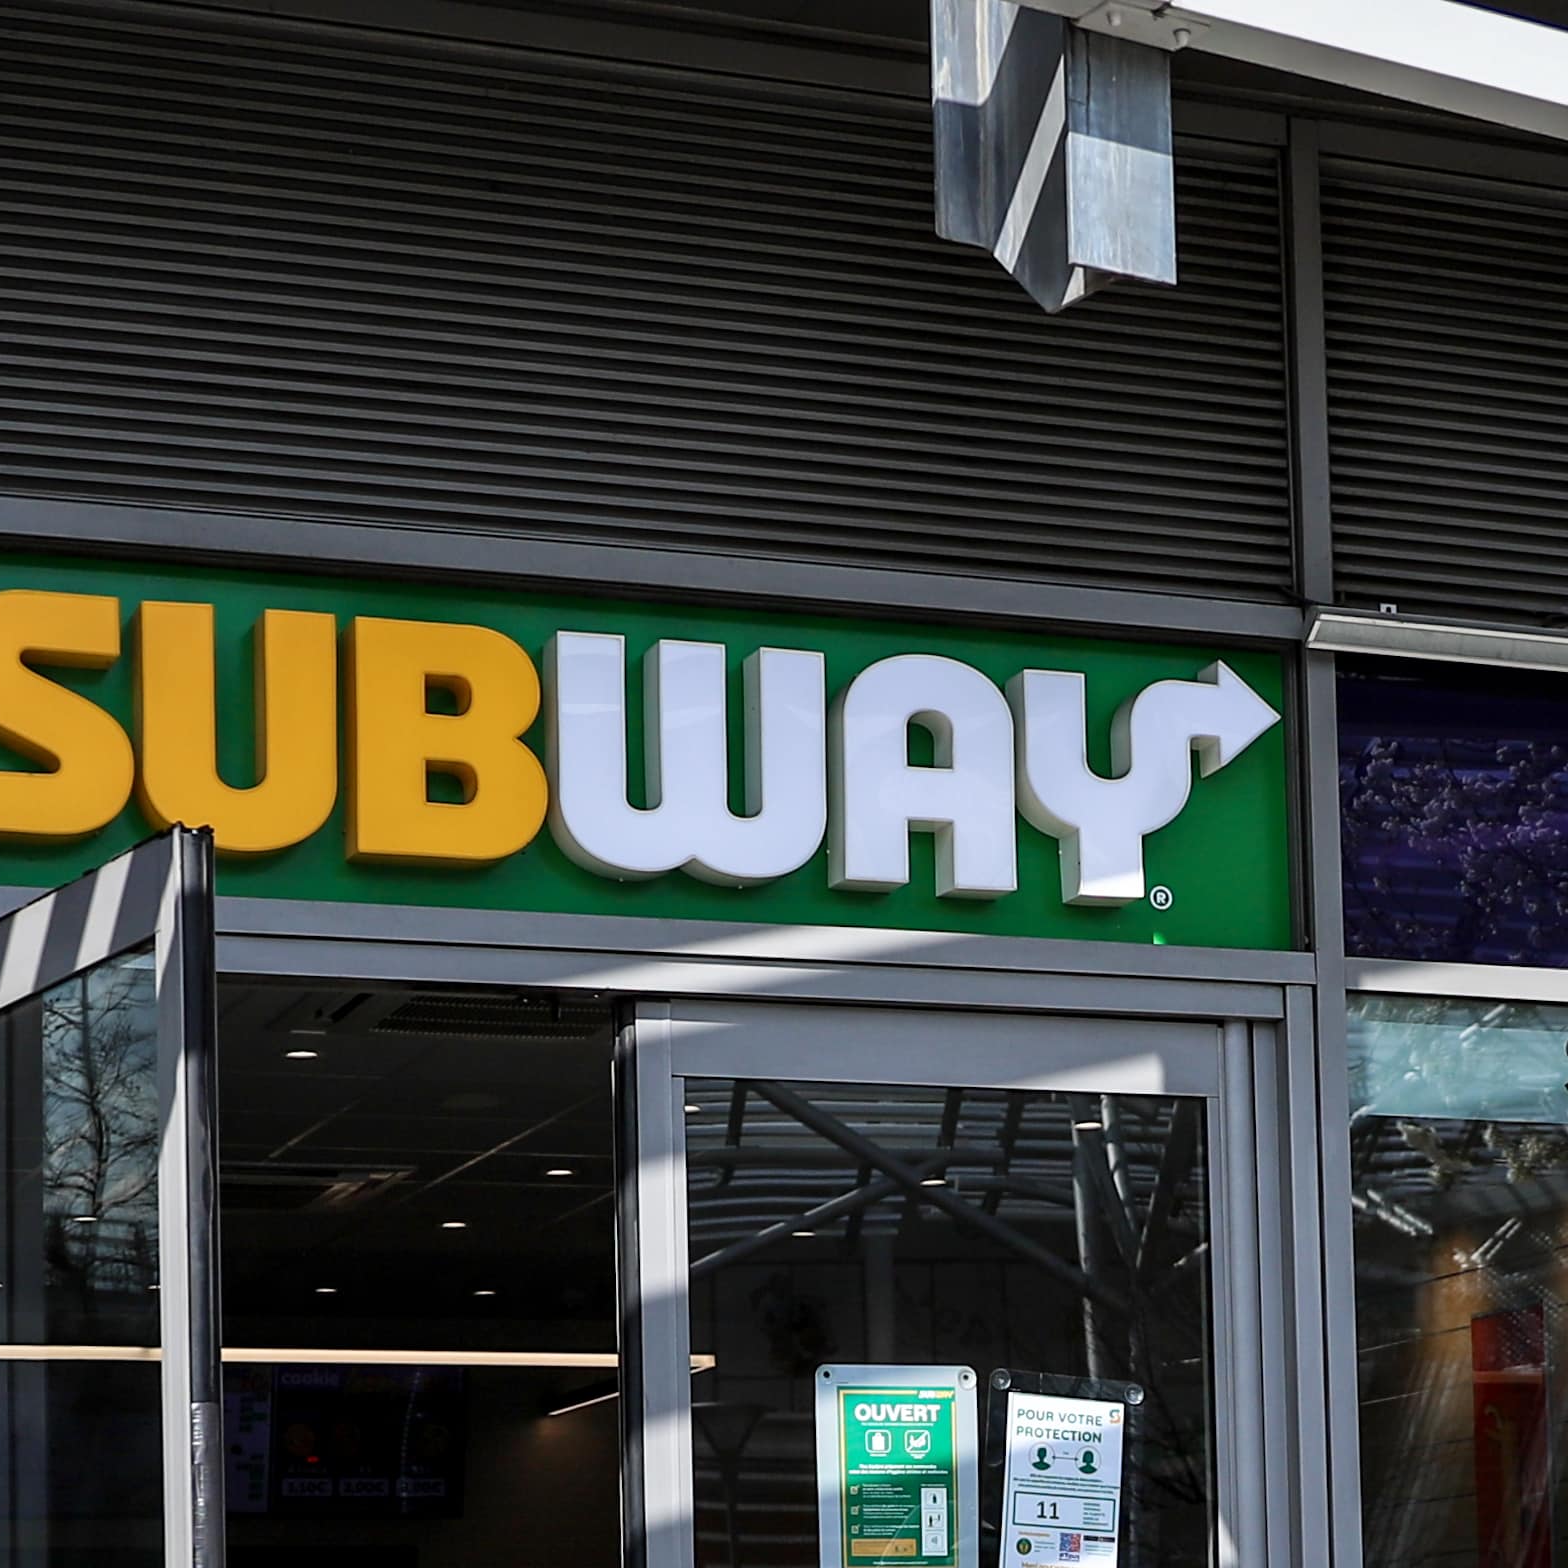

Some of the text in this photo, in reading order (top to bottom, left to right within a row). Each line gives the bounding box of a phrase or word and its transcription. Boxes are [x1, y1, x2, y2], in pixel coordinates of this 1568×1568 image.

[854, 1403, 941, 1422] OUVERT
[1017, 1408, 1103, 1426] POUR VOTRE
[1016, 1425, 1103, 1443] PROTECTION
[1036, 1501, 1060, 1520] 11
